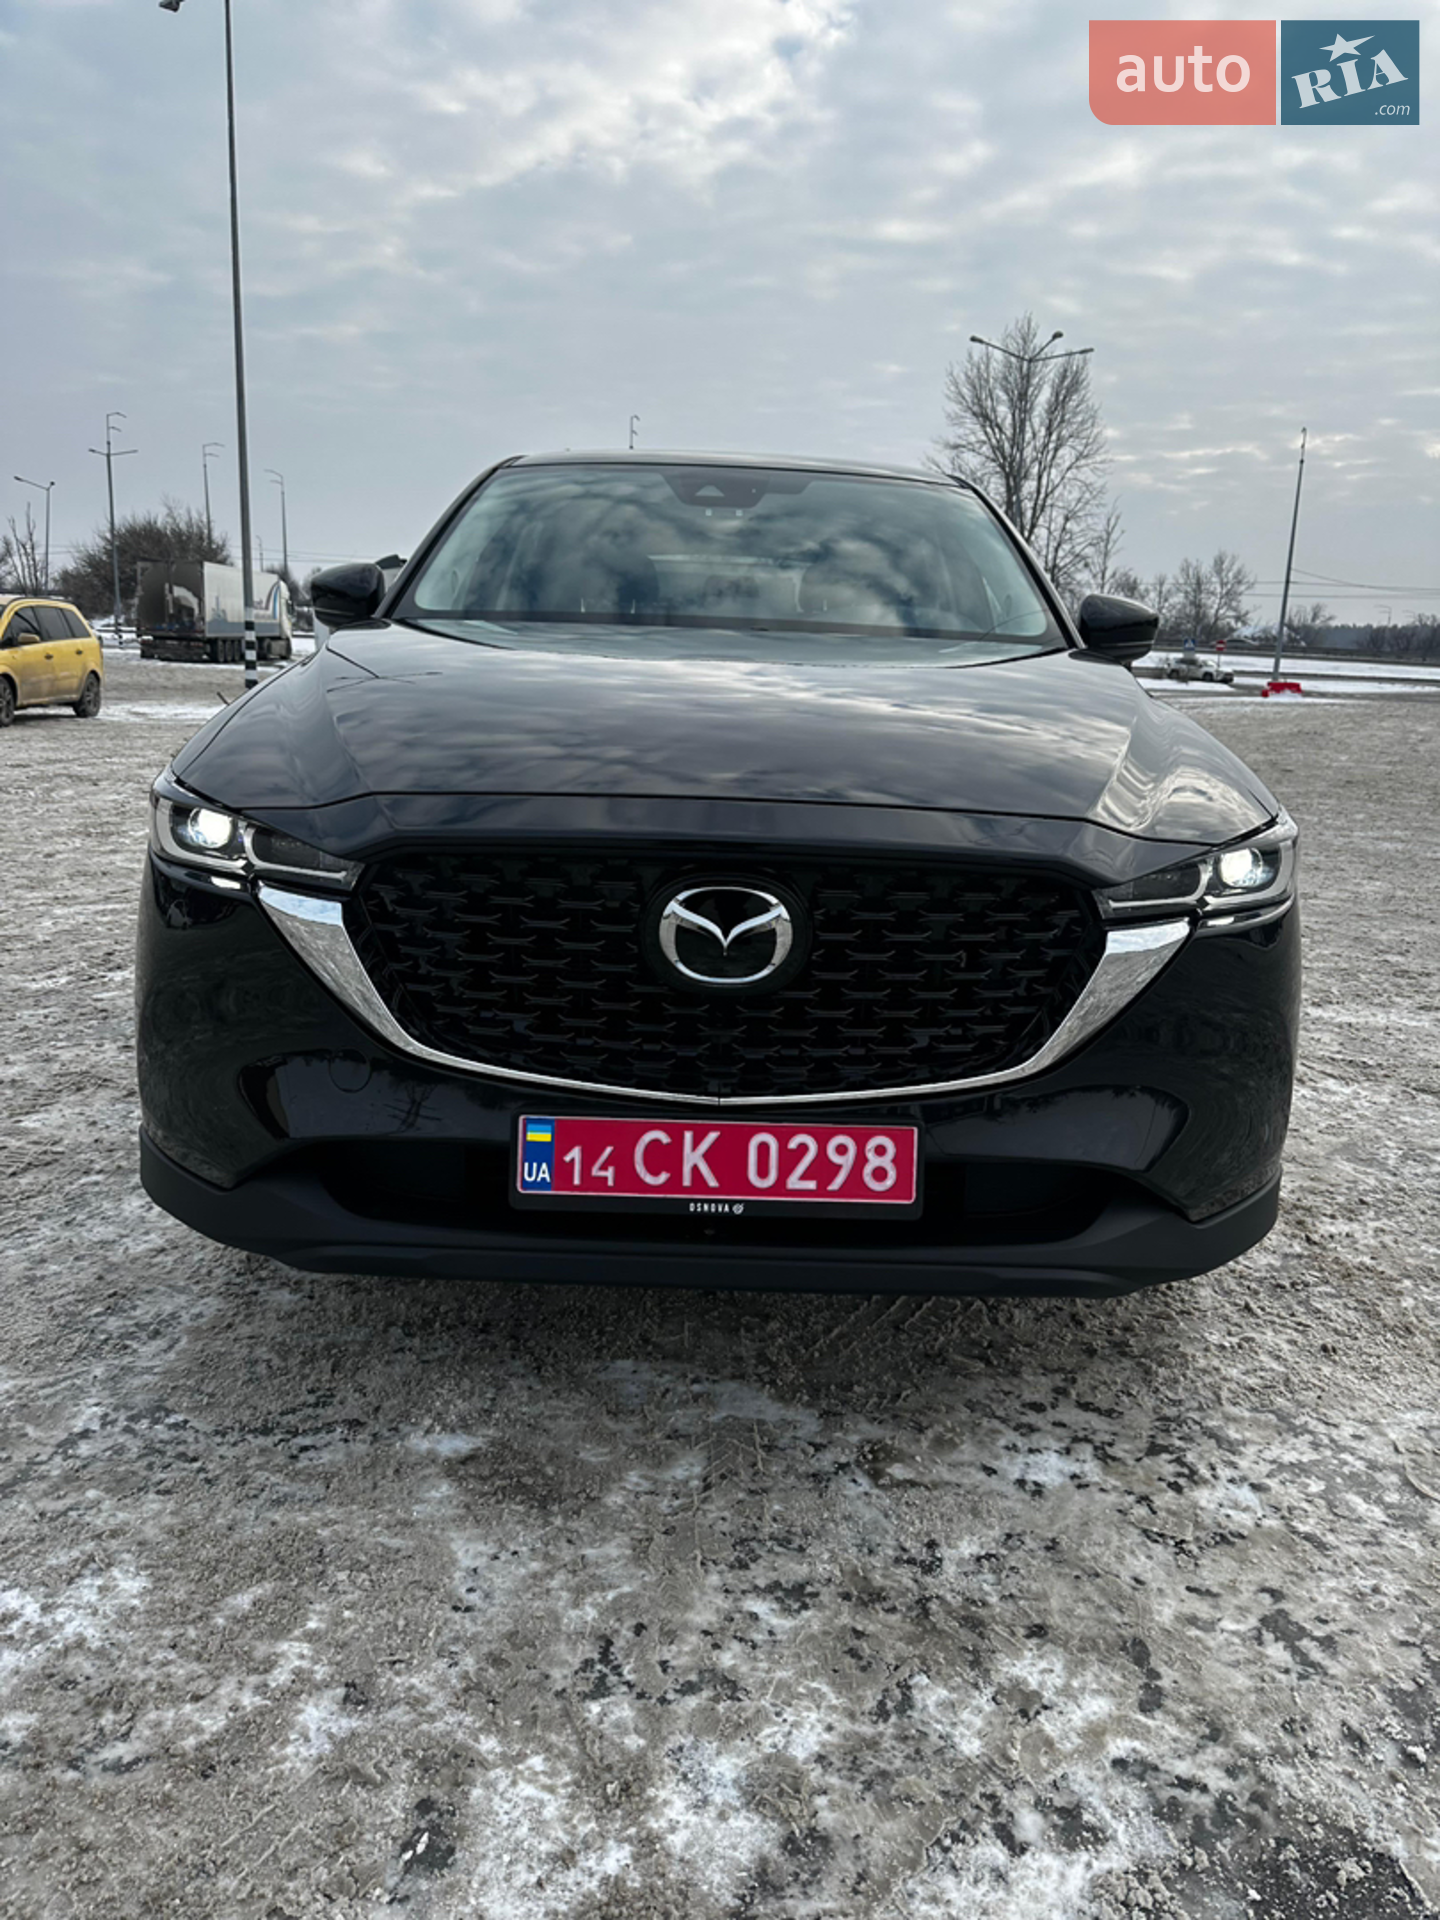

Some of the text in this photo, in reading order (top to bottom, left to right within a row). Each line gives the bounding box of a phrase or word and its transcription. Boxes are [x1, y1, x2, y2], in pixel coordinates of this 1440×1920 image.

[523, 1162, 551, 1182] UA
[562, 1145, 615, 1187] 14
[746, 1132, 898, 1192] 0298
[689, 1202, 730, 1213] OSNOVA
